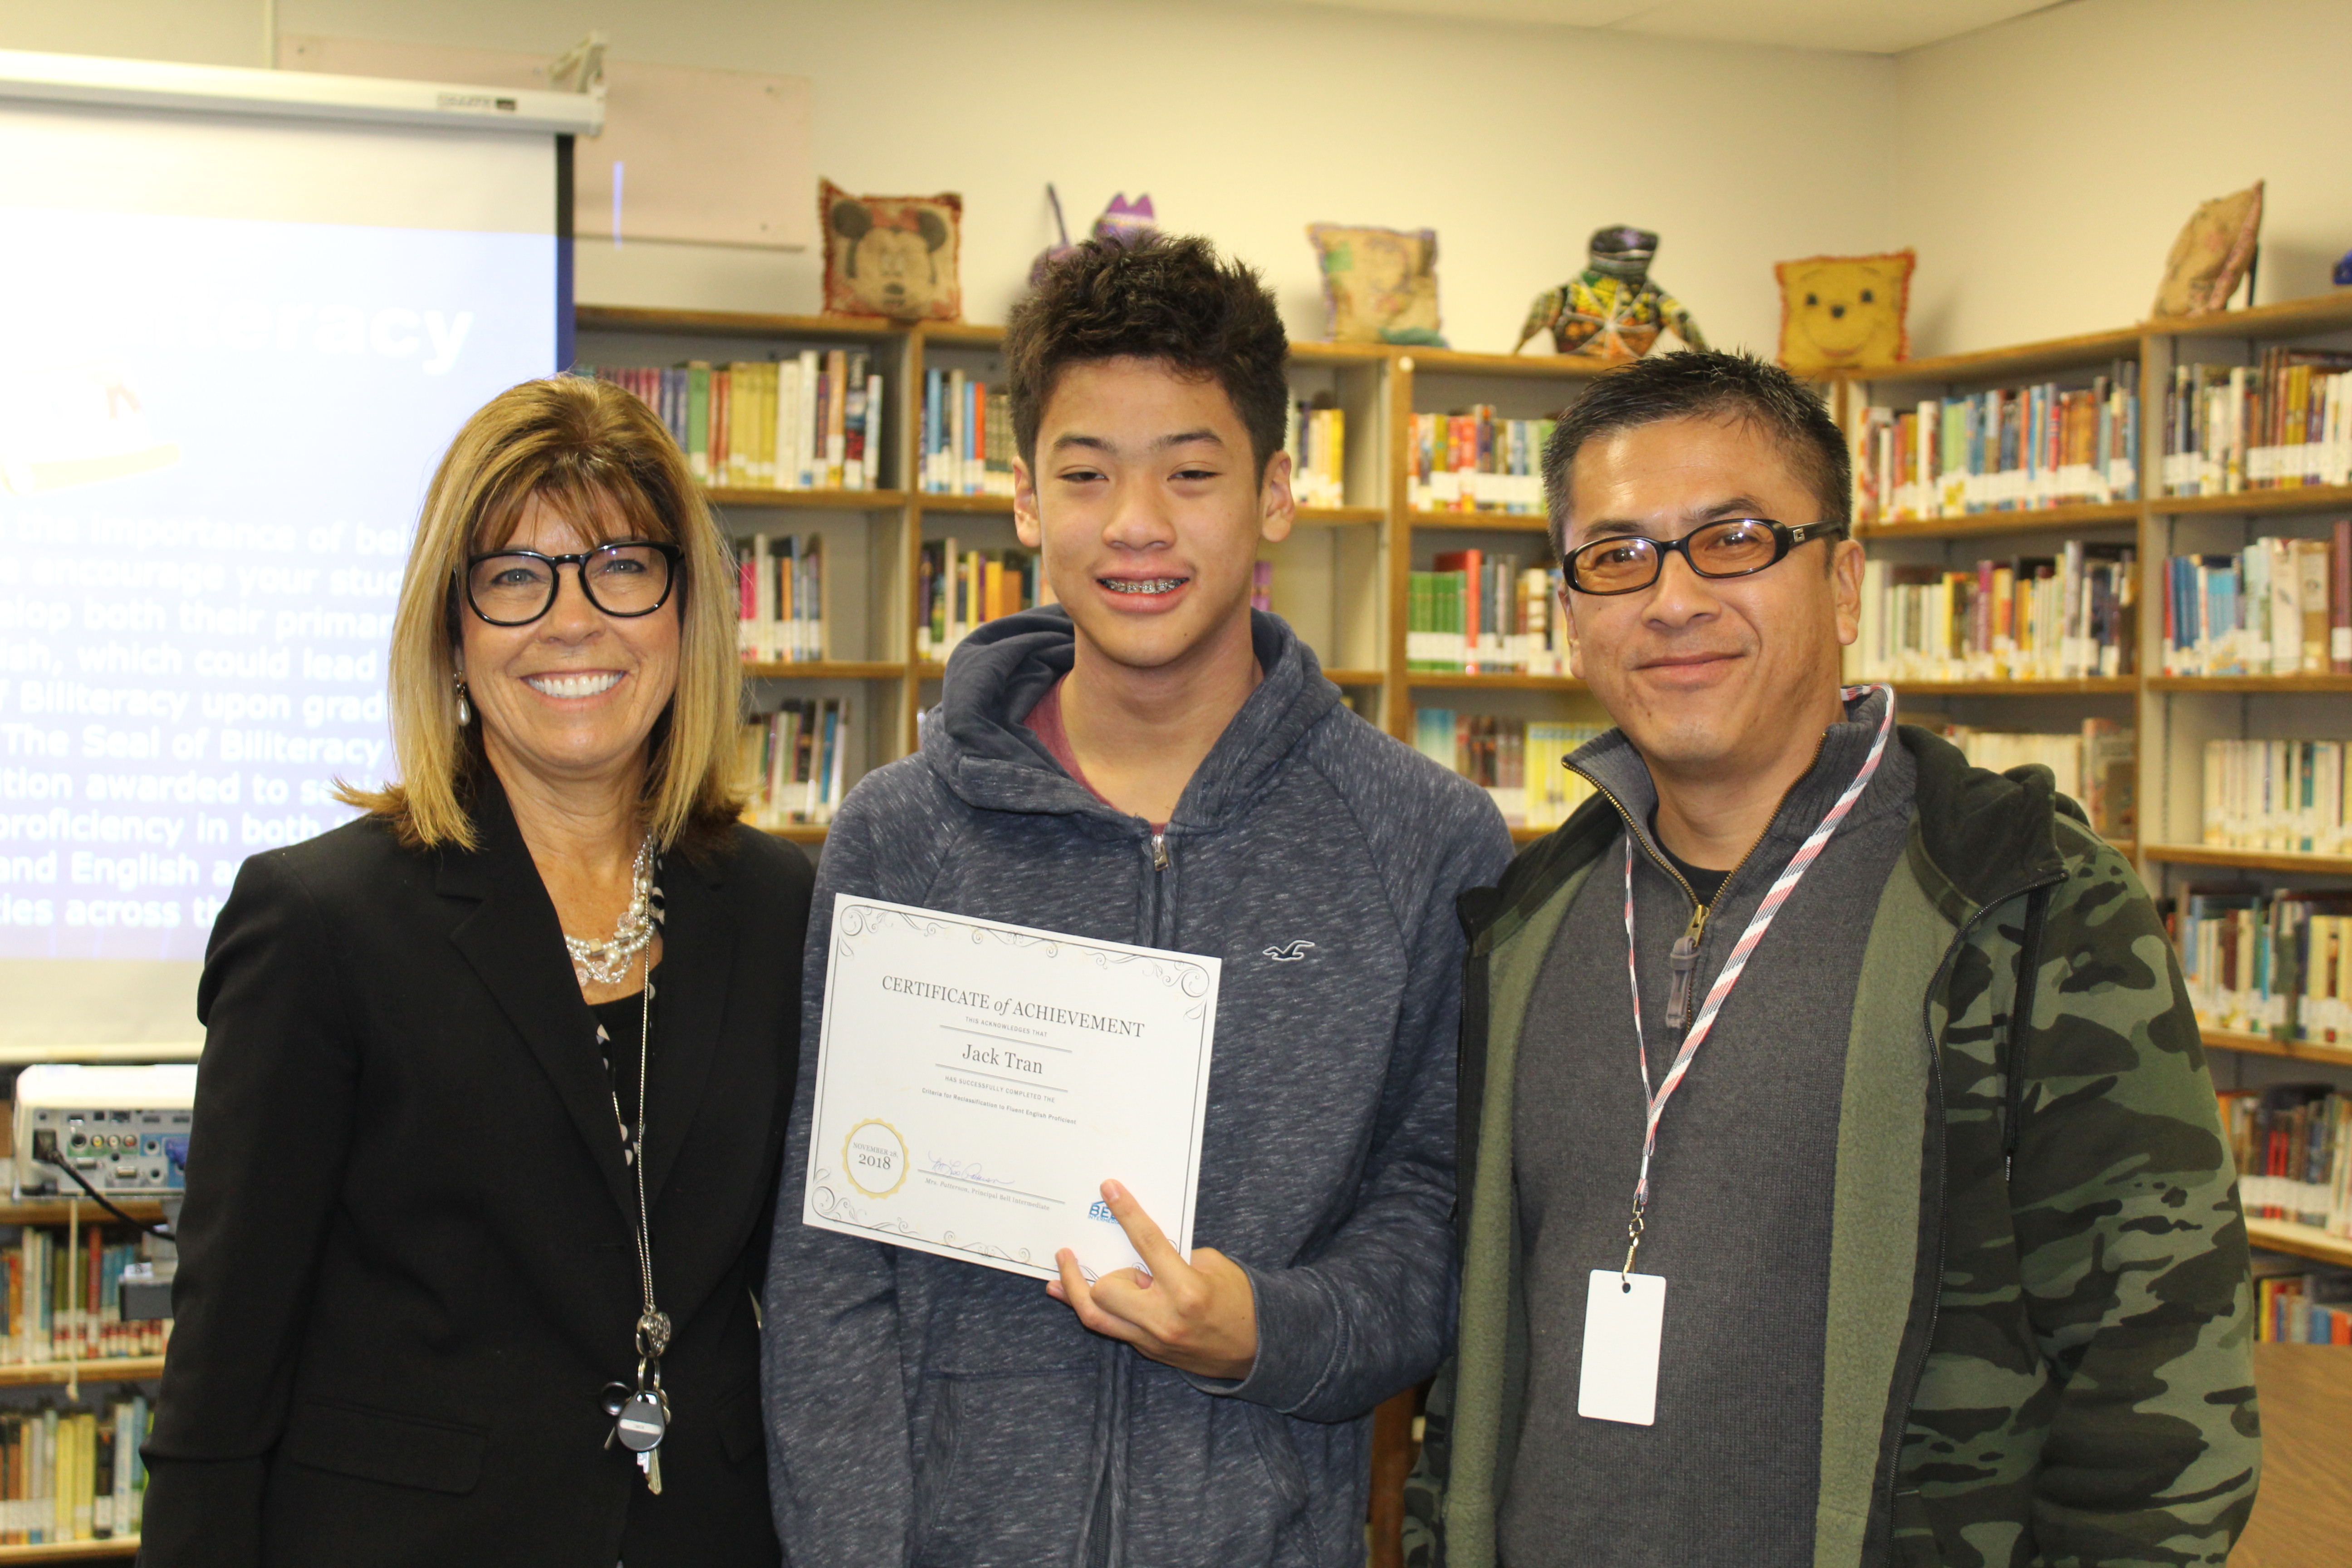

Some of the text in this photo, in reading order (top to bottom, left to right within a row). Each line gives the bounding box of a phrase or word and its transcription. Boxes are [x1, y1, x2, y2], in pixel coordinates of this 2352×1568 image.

[92, 510, 296, 554] importance
[308, 520, 346, 554] of
[32, 557, 225, 597] encourage
[236, 564, 319, 597] your
[84, 596, 166, 632] both
[179, 599, 265, 634] their
[77, 639, 182, 675] which
[194, 645, 289, 679] could
[303, 646, 377, 681] lead
[20, 680, 188, 721] Biliteracy
[202, 691, 290, 723] upon
[1, 722, 384, 768] The Seal of Biliteracy
[4, 766, 73, 799] tion
[85, 770, 240, 802] awarded
[252, 773, 288, 804] to
[197, 812, 228, 844] in
[71, 851, 199, 890] English
[65, 899, 180, 927] across
[882, 975, 1145, 1038] CERTIFICATE of ACHIEVEMENT
[965, 1016, 1048, 1038] THIS ACKNOWLEDGES THAT
[962, 1044, 1043, 1074] Jack Tran
[921, 1087, 942, 1097] Criteria
[953, 1094, 998, 1108] Reclassification
[1006, 1105, 1024, 1114] Fluent
[1025, 1109, 1047, 1119] English
[1048, 1113, 1077, 1125] Proficient
[959, 1078, 1004, 1093] SUCCESSFULLY
[1005, 1088, 1042, 1100] COMPLETED
[853, 1142, 888, 1156] NOVEMBER
[858, 1153, 891, 1170] 2018
[925, 1177, 938, 1186] Mrs.
[971, 1188, 998, 1199] Principal
[999, 1194, 1011, 1202] Bell
[1013, 1197, 1050, 1211] Intermediate
[1089, 1204, 1116, 1220] BE
